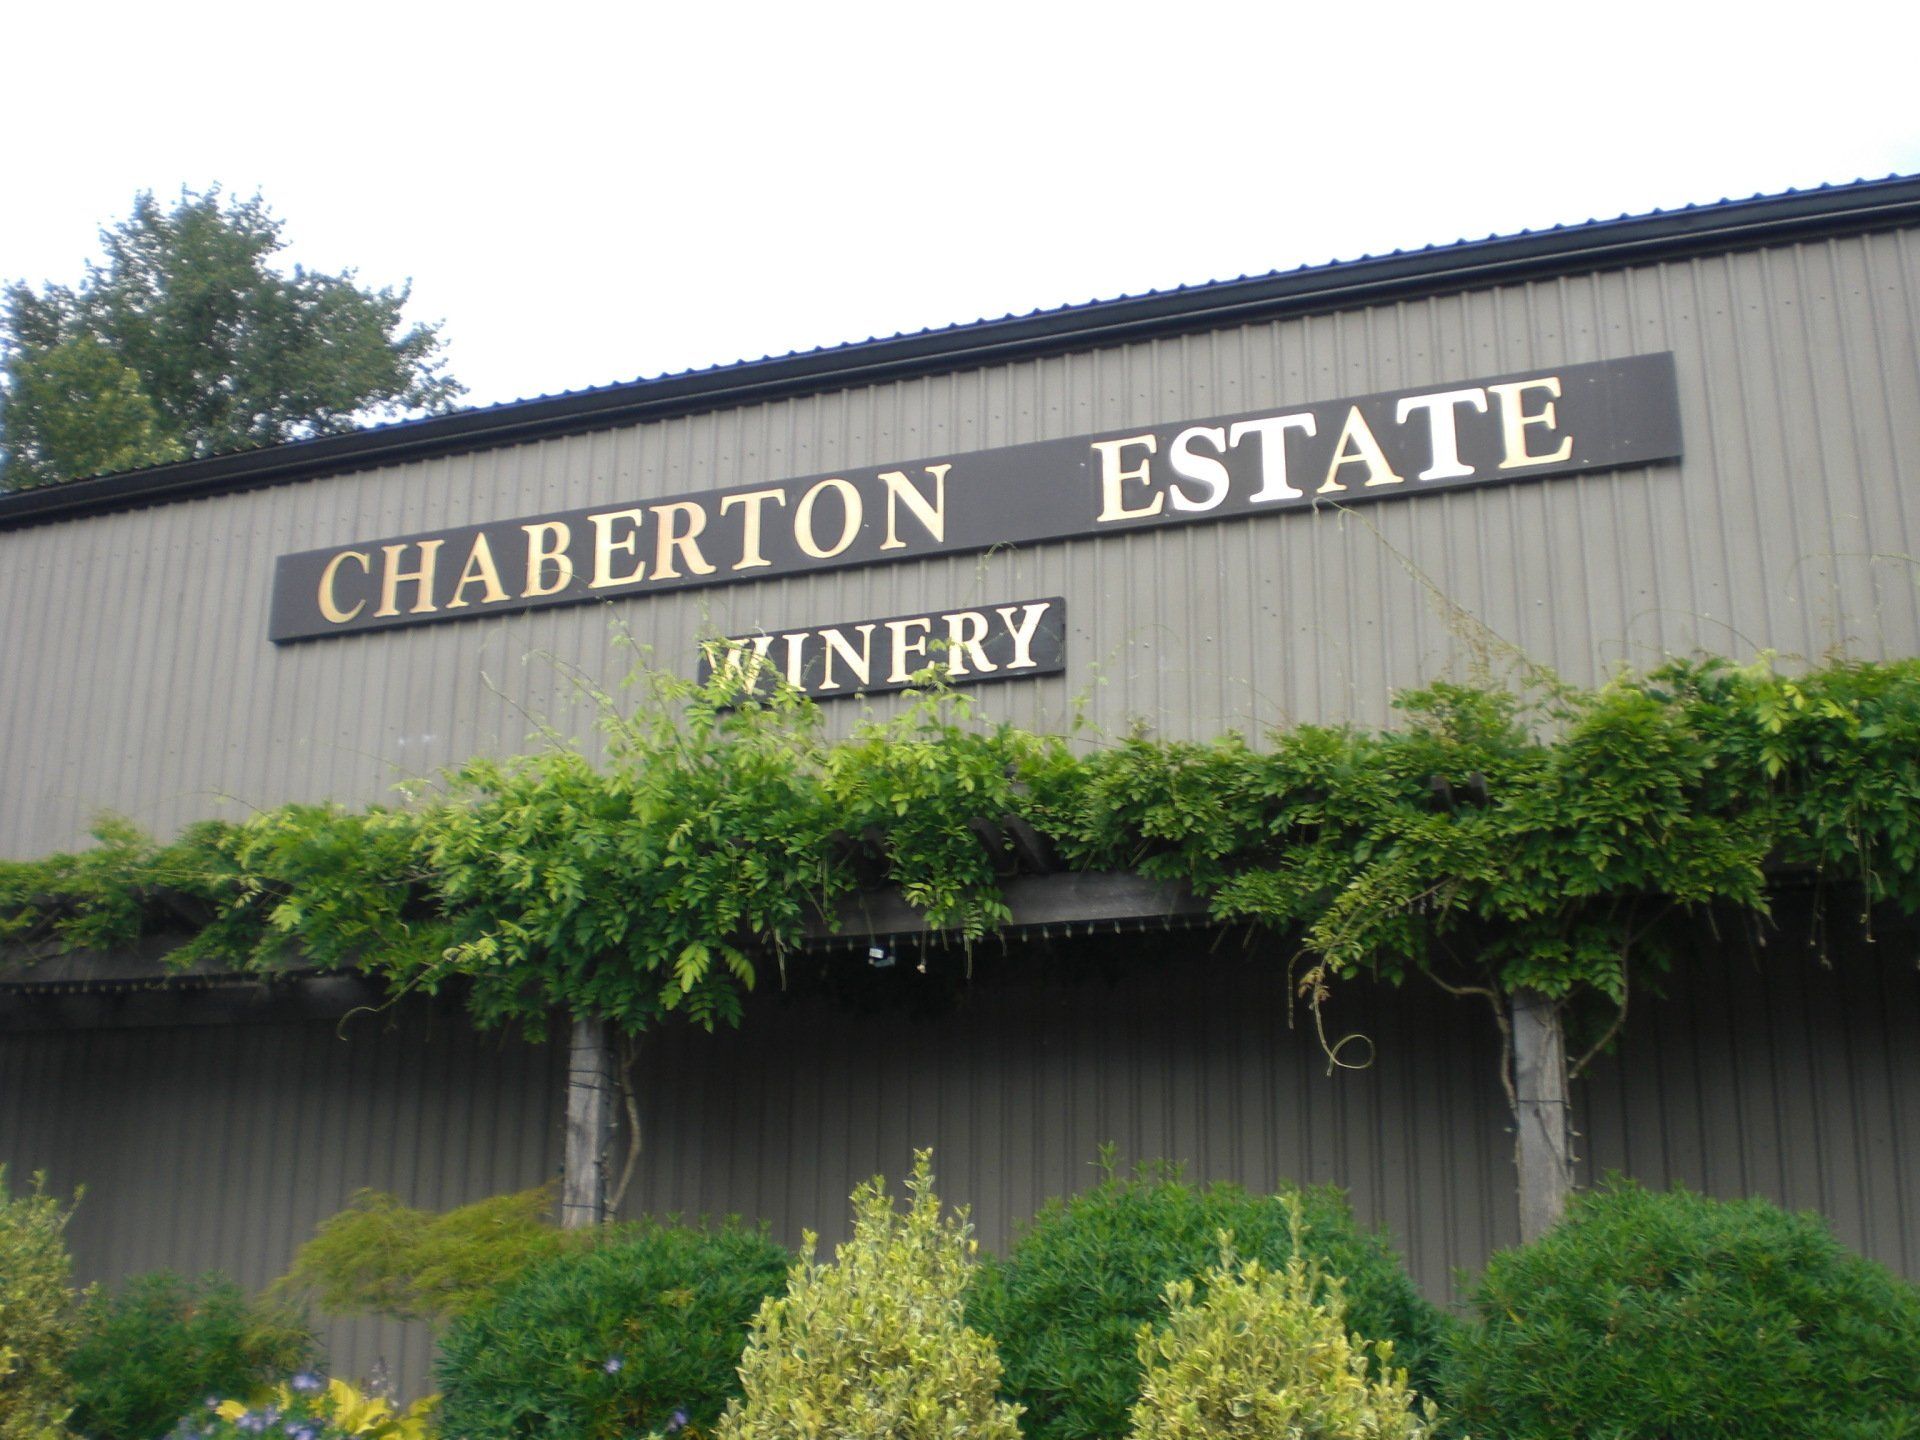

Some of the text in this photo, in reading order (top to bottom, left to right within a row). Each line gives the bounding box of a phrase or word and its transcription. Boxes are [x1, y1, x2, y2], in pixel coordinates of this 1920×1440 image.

[317, 376, 1574, 625] CHABERTON ESTATE
[699, 602, 1051, 694] WINERY
